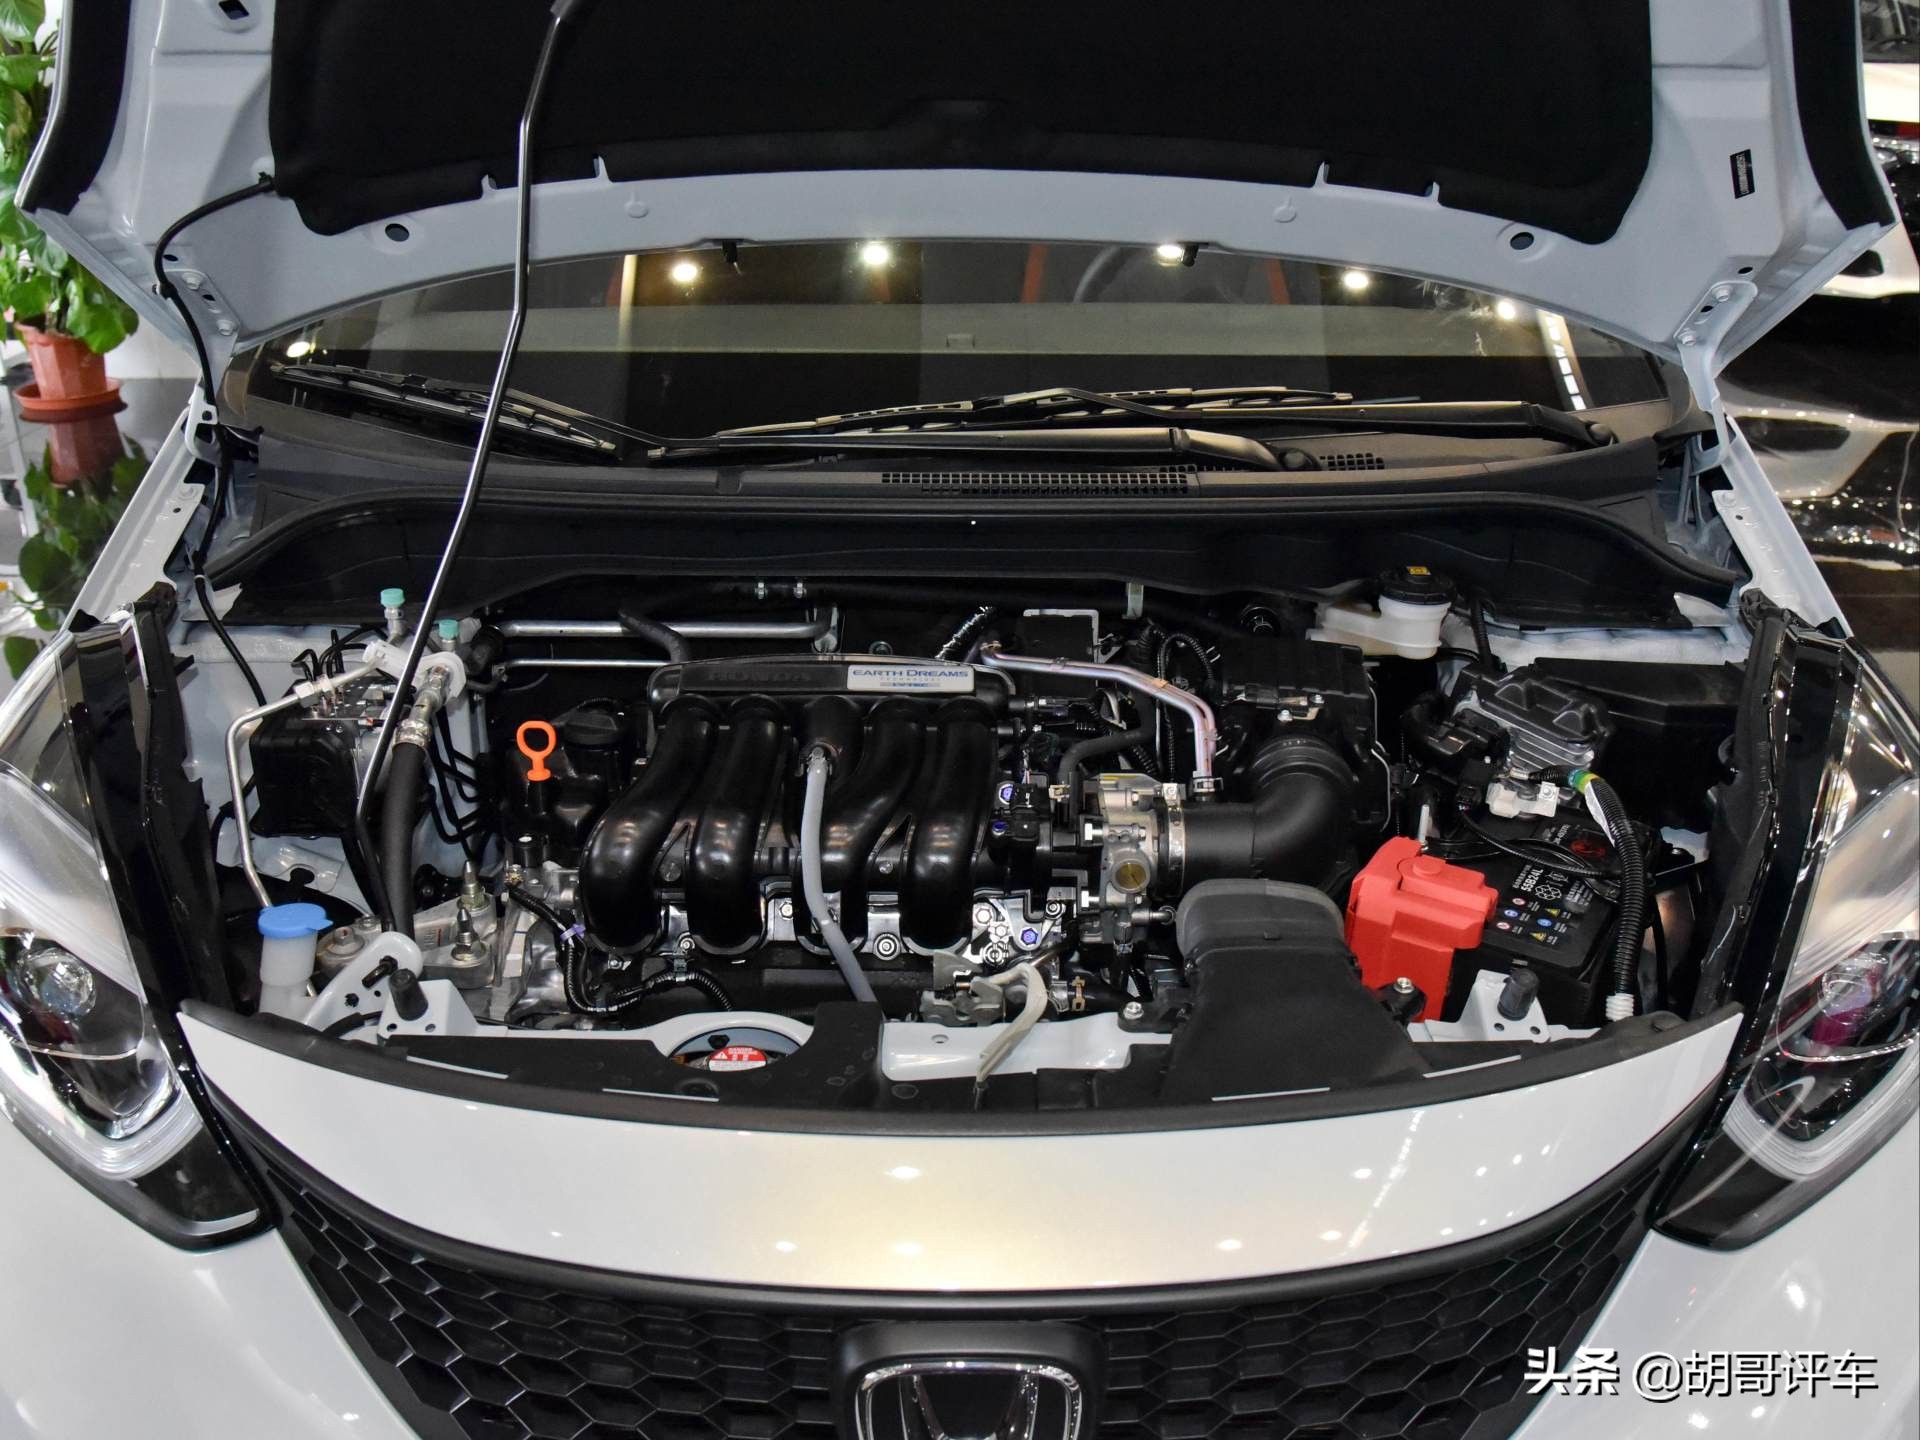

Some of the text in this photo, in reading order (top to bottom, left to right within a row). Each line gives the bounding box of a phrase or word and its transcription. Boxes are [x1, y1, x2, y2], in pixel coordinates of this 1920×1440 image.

[852, 669, 969, 678] EARTH DREAMS
[1520, 869, 1544, 892] 55B24L
